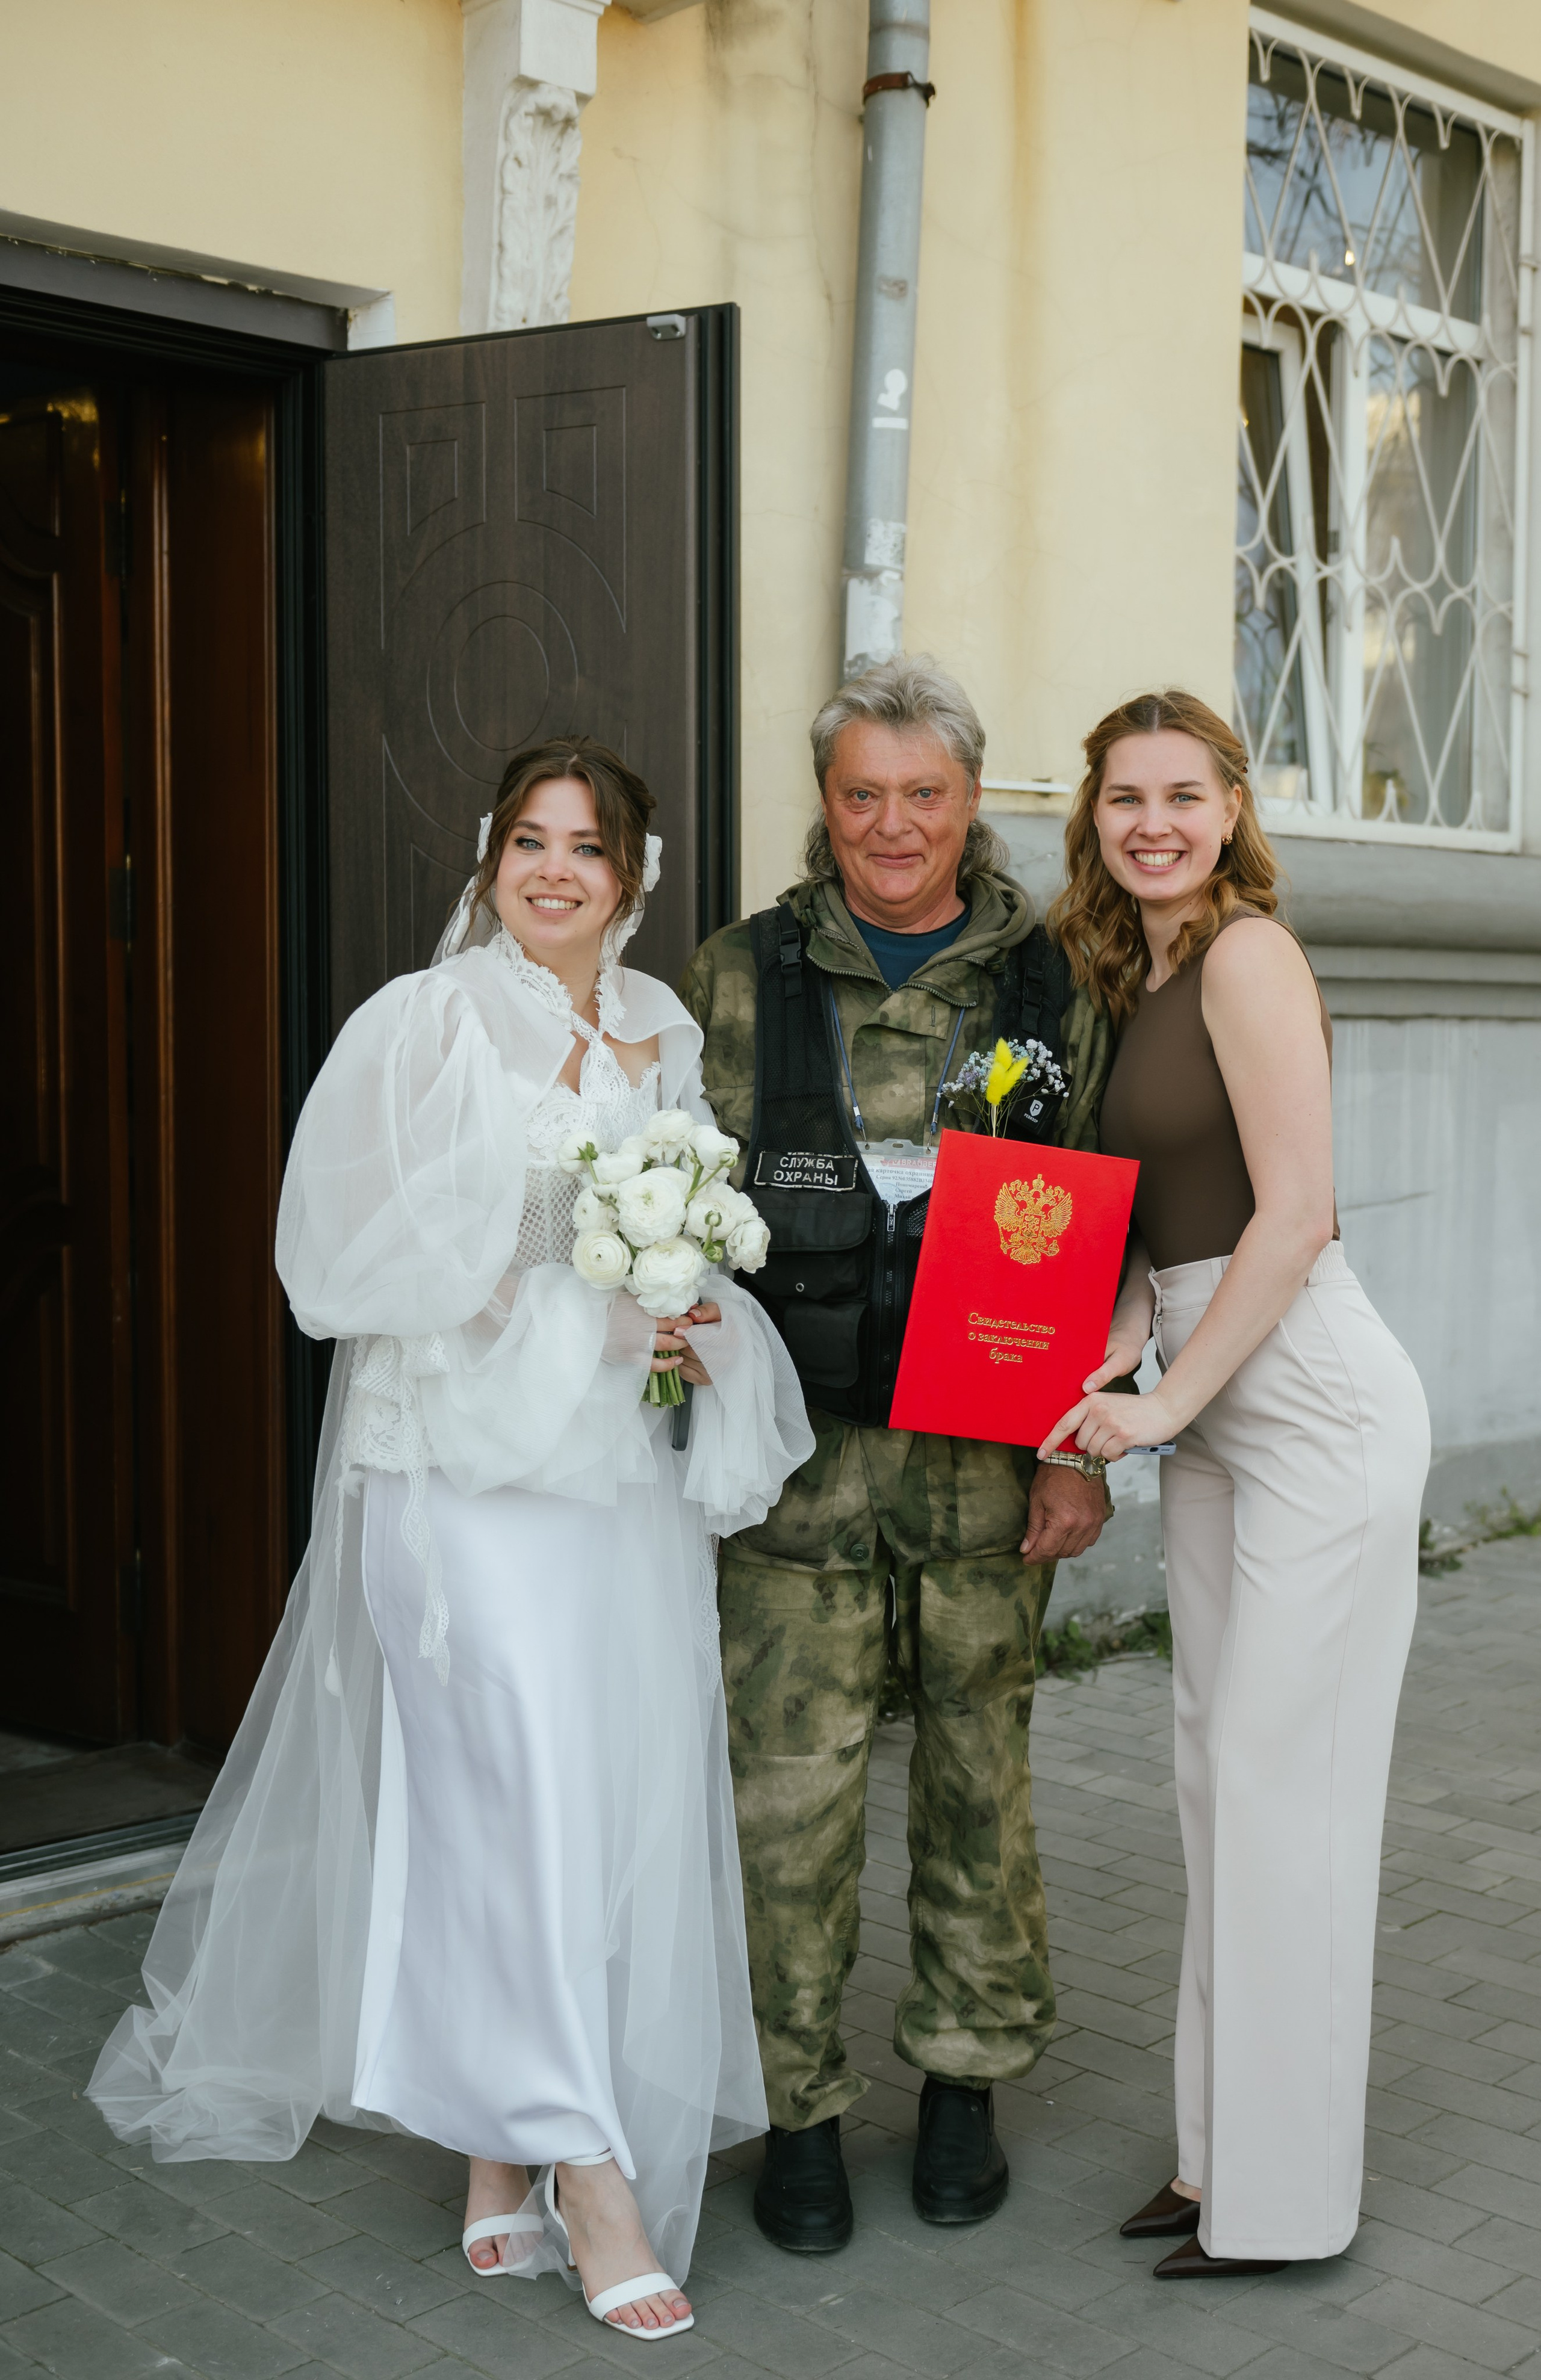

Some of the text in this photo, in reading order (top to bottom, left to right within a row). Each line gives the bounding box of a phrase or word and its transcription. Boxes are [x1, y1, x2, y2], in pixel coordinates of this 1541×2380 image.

[780, 1157, 834, 1171] СЛУЖБА
[902, 1159, 936, 1167] BRAUBER
[774, 1170, 838, 1185] ОХРАНЫ
[968, 1312, 1055, 1335] Свидетельство
[968, 1332, 1050, 1350] о заключении
[989, 1347, 1023, 1364] брака
